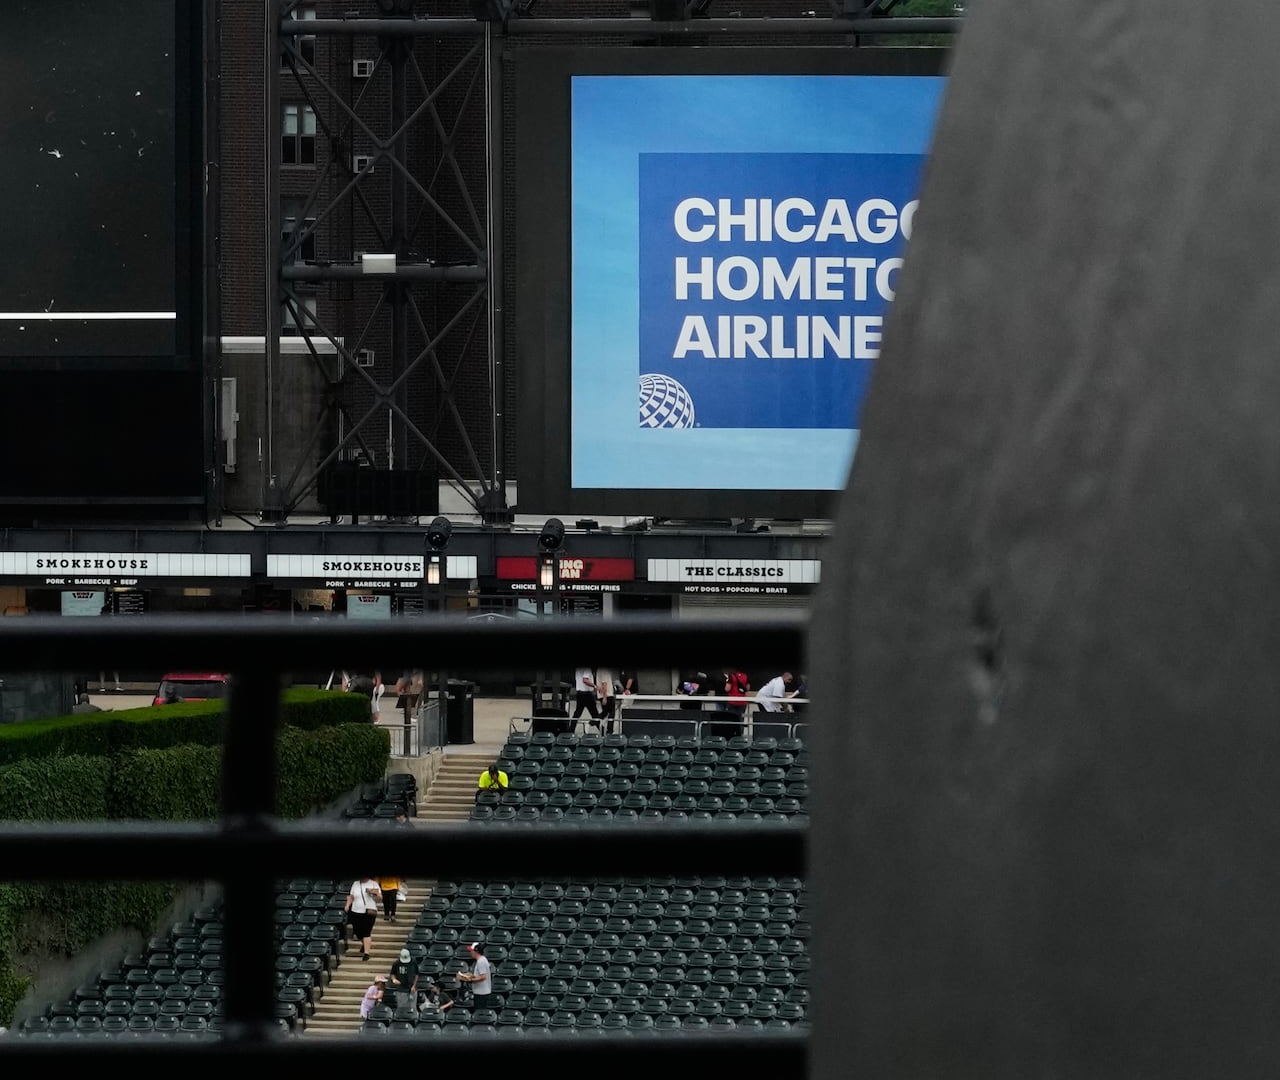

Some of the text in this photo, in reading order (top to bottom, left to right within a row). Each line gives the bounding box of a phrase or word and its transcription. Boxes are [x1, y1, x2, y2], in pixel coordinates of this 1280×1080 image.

[673, 315, 883, 359] AIRLINE
[36, 559, 148, 569] SMOKEHOUSE
[322, 561, 421, 571] SMOKEHOUSE
[685, 567, 784, 577] THE CLASSICS
[600, 584, 621, 592] FRIES
